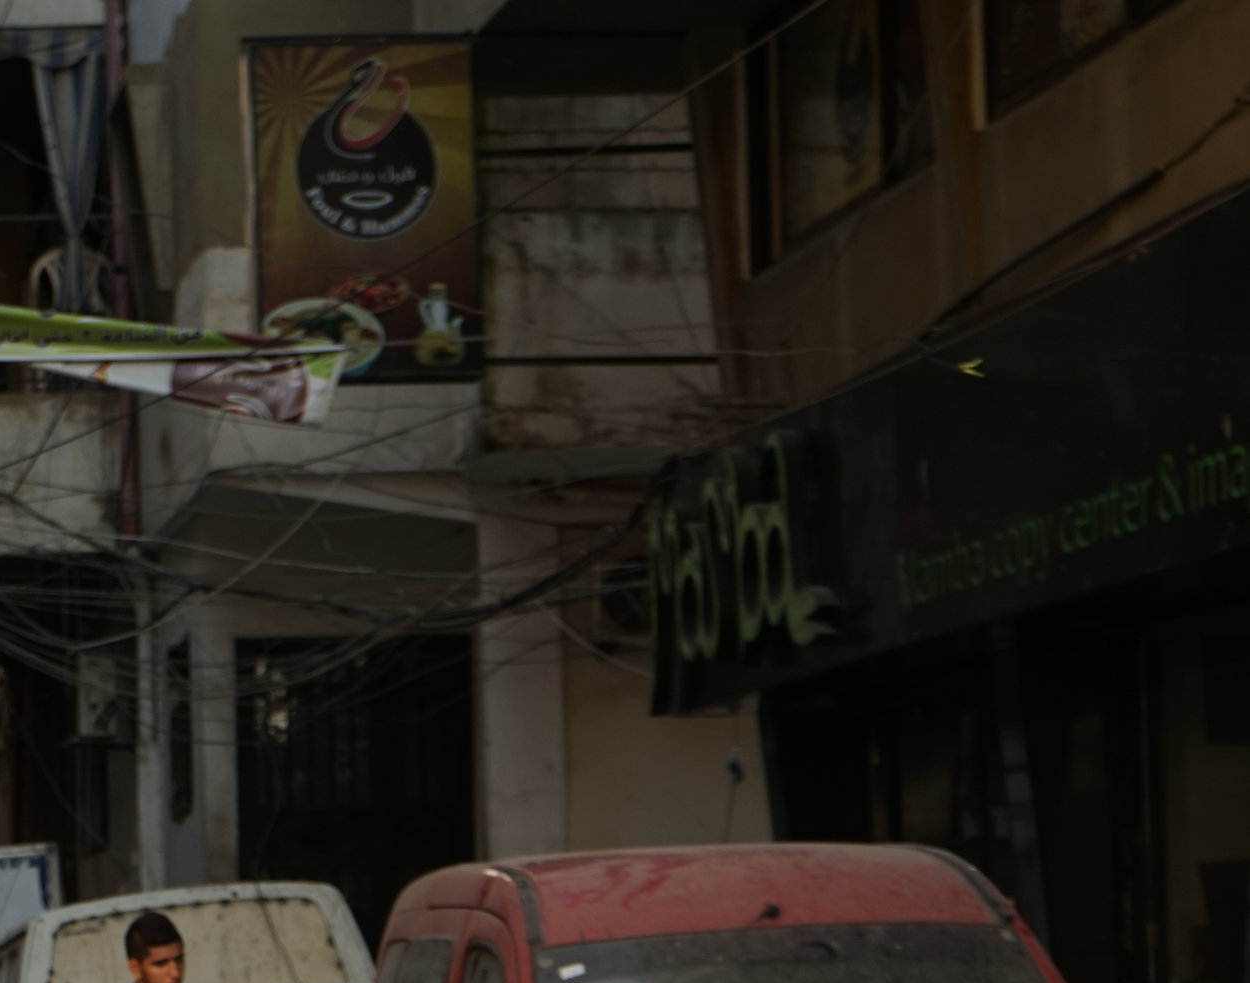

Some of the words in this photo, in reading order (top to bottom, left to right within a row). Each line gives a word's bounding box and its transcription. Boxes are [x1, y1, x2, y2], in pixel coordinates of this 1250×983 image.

[990, 511, 1052, 589] copy
[1058, 474, 1156, 555] center
[1157, 449, 1186, 524] &
[1185, 440, 1250, 514] ima
